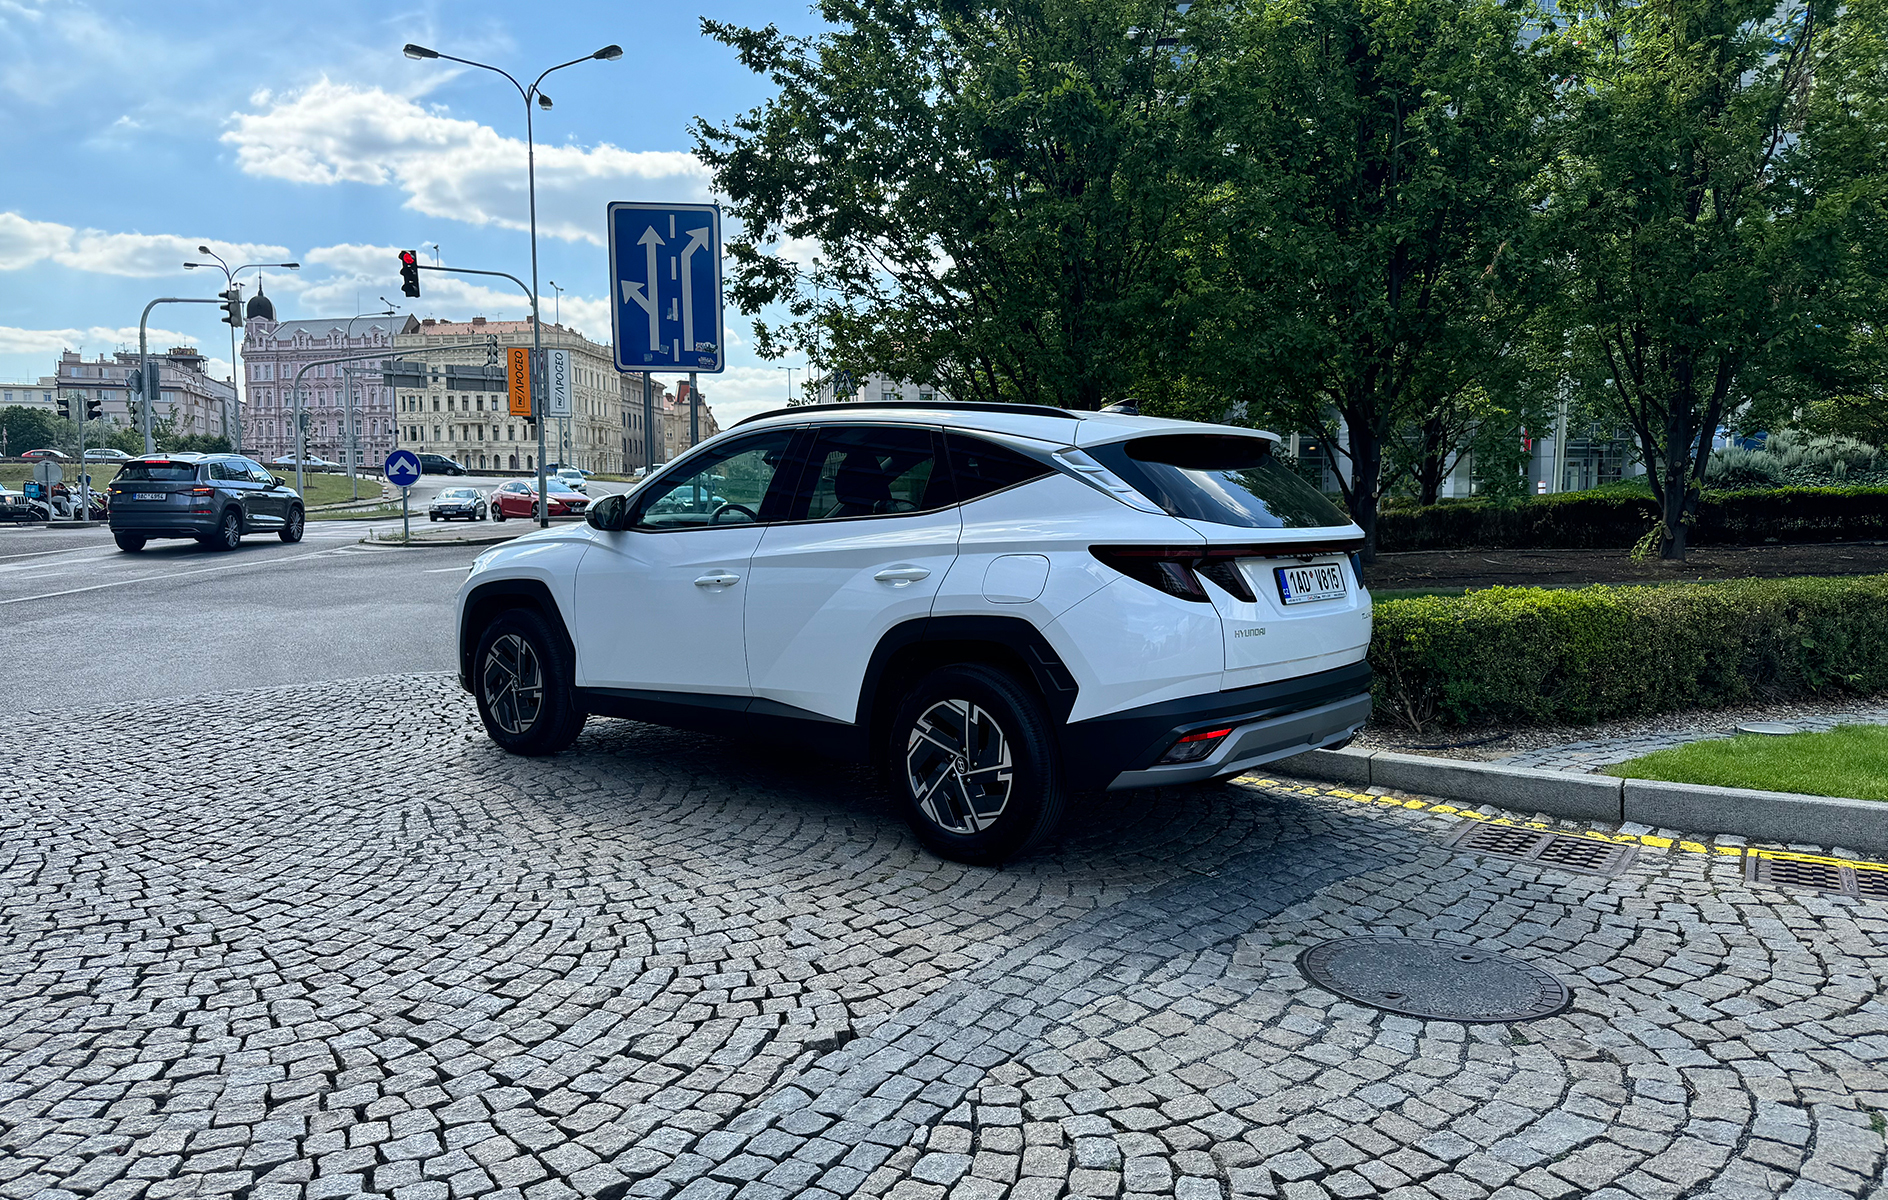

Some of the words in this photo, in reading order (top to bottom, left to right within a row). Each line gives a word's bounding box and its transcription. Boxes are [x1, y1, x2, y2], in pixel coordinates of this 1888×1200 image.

[1290, 571, 1311, 594] 1AD
[1314, 568, 1339, 591] V815
[1234, 627, 1266, 638] HYUNDAI
